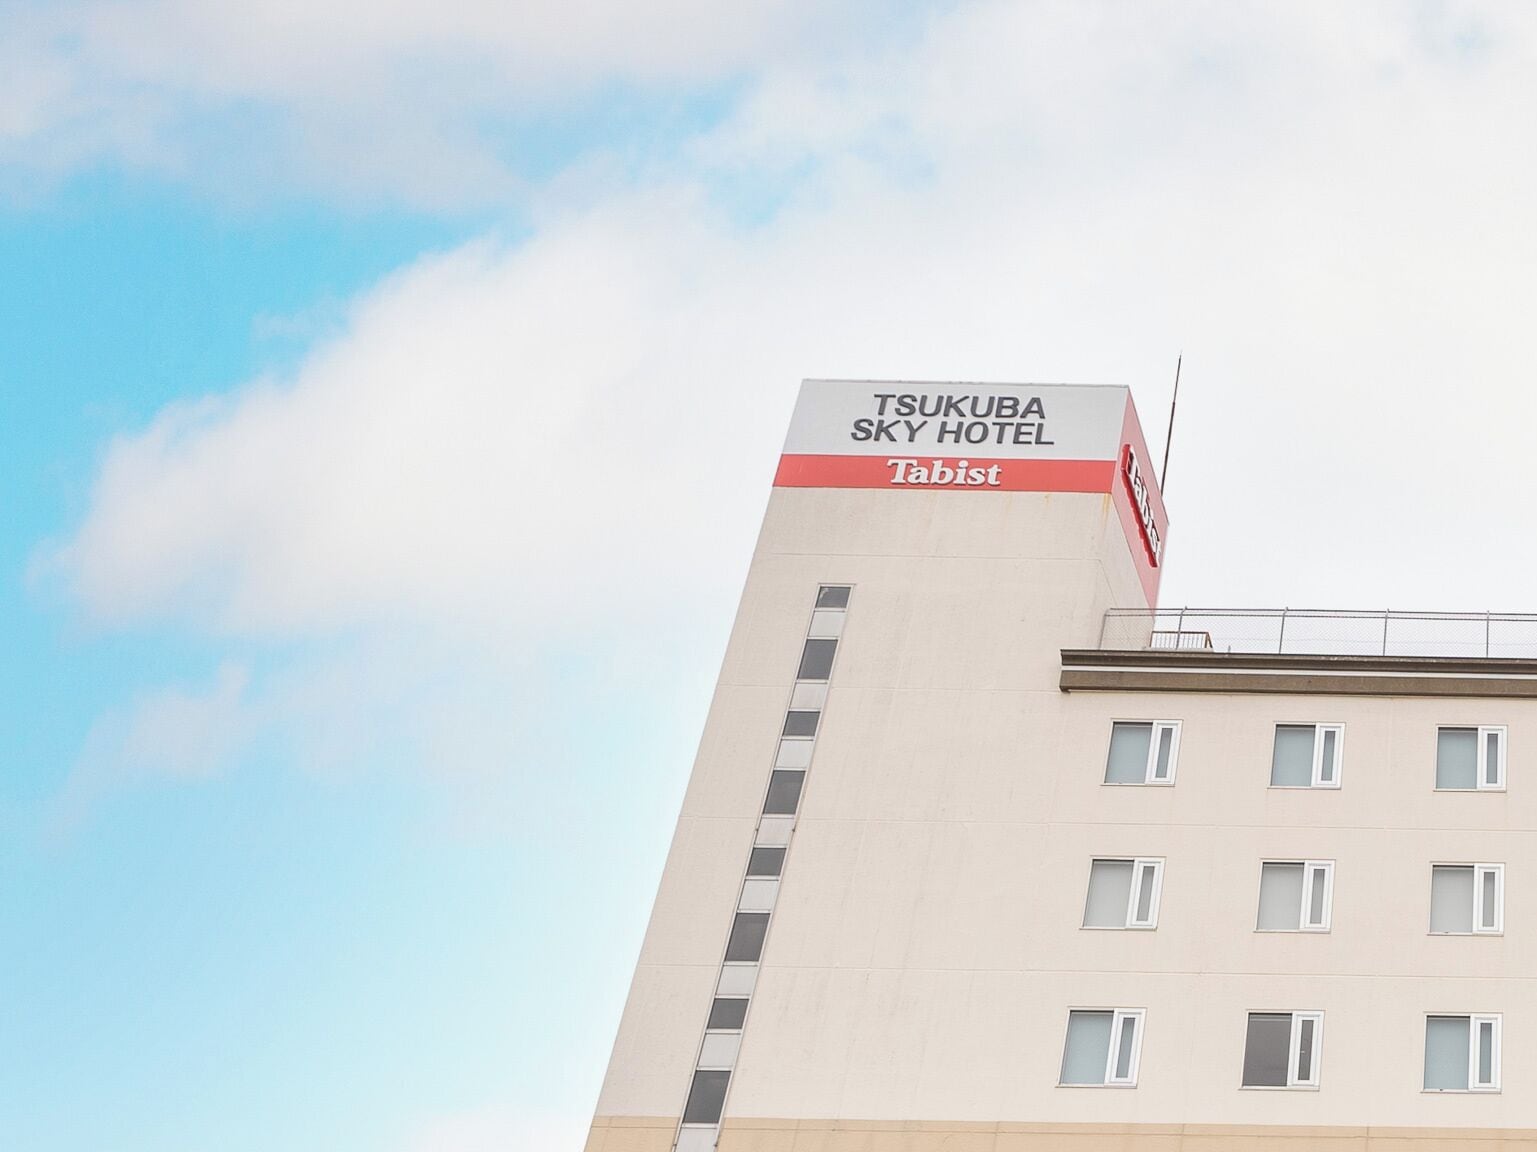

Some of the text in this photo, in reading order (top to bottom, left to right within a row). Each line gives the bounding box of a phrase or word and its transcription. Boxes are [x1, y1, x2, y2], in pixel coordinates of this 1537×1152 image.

[874, 393, 1046, 420] TSUKUBA
[851, 418, 1055, 446] SKY HOTEL
[887, 458, 1003, 487] Tabist
